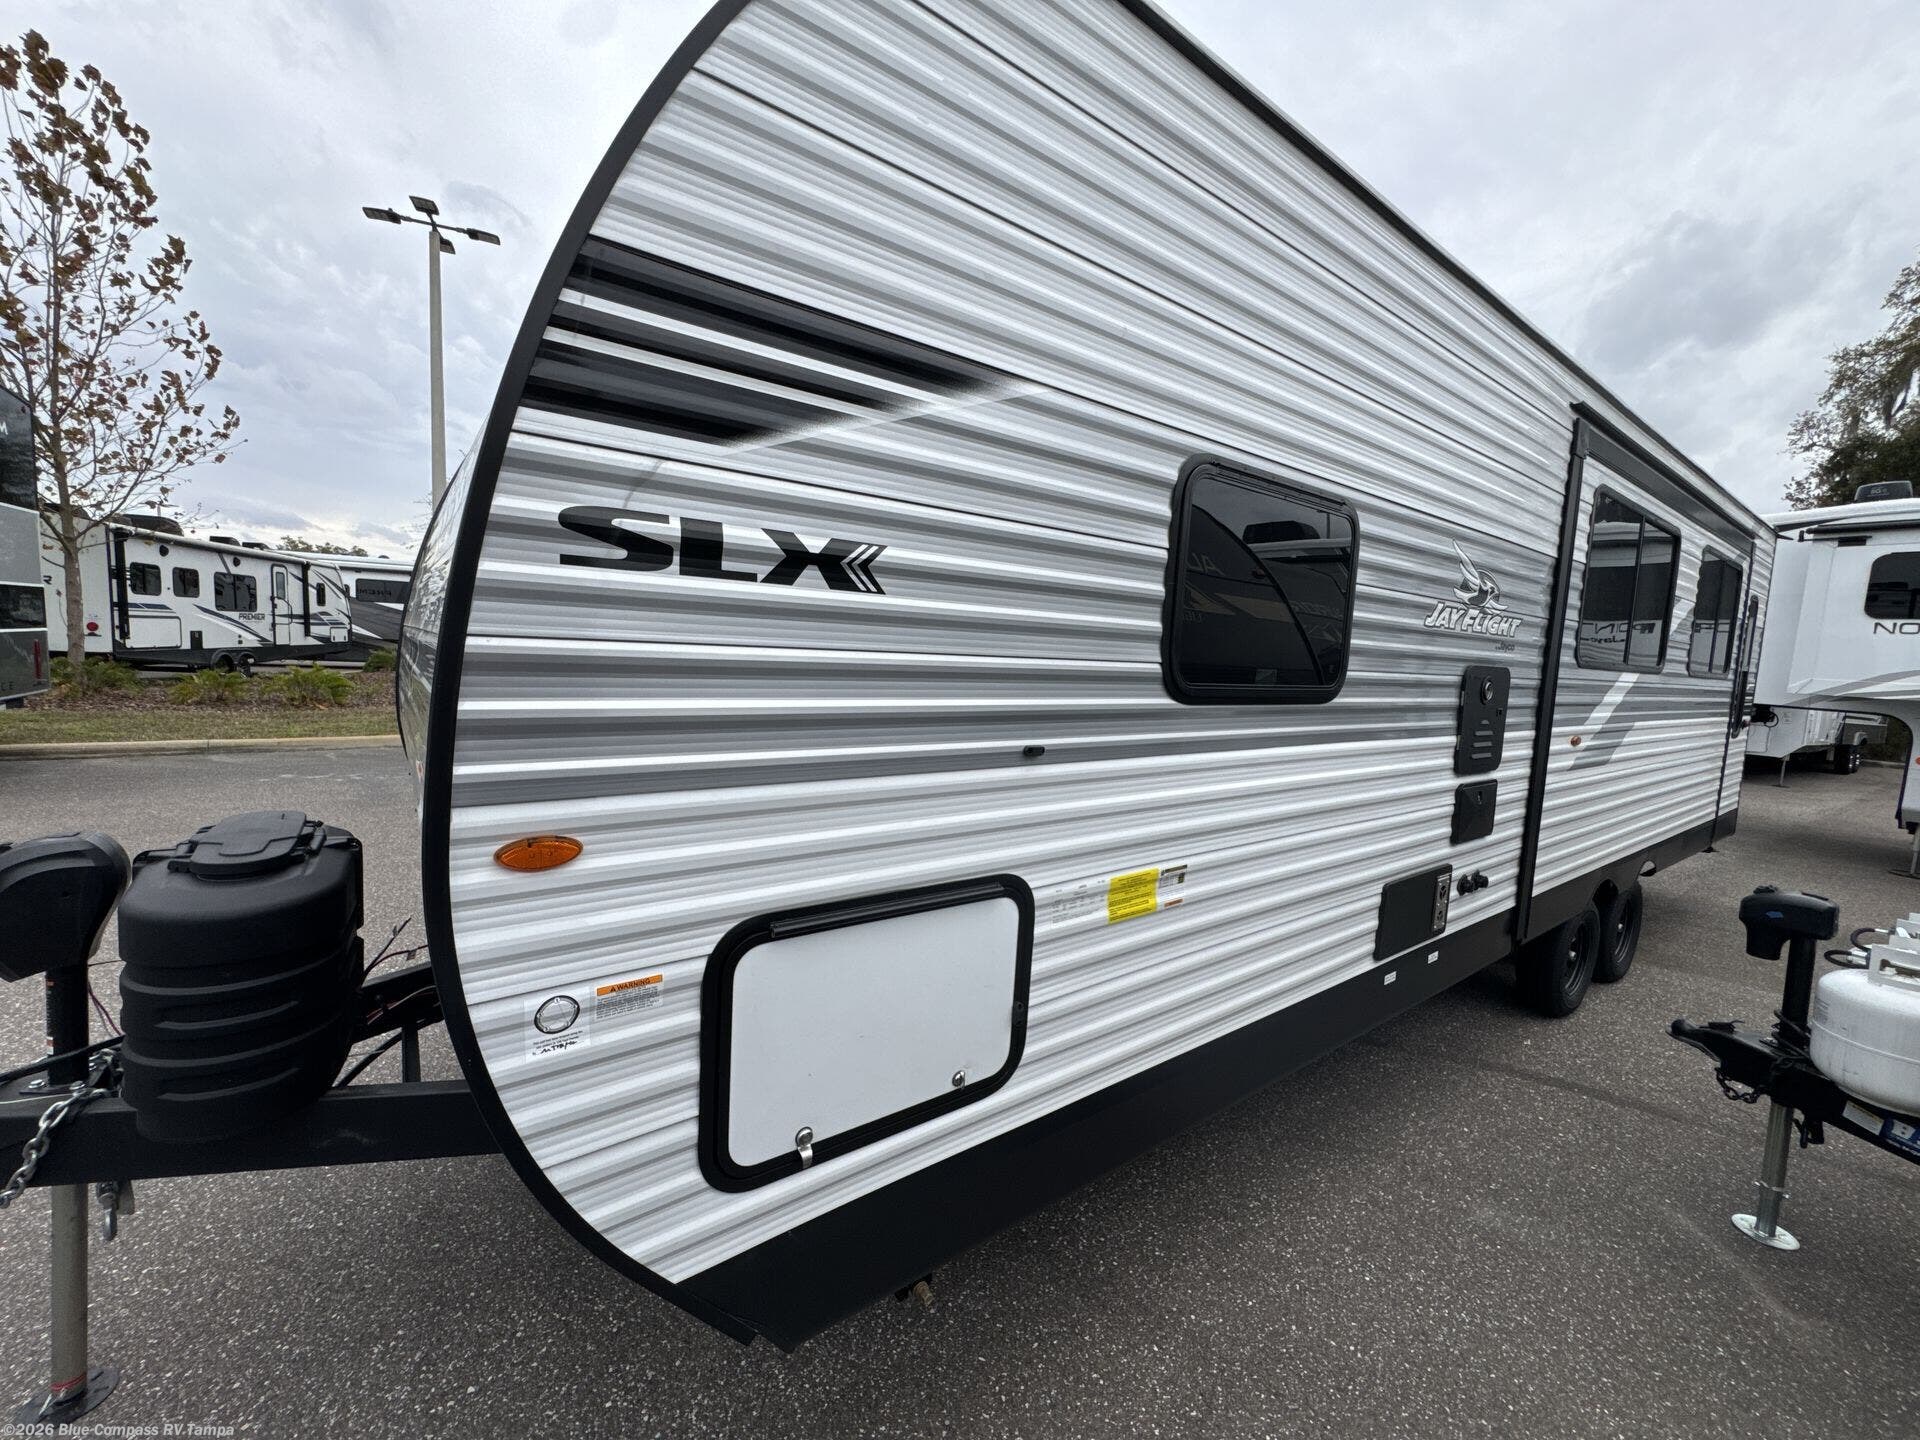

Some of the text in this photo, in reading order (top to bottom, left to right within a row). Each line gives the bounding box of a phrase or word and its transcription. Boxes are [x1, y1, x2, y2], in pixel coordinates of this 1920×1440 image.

[558, 505, 888, 595] SLX
[1424, 601, 1522, 638] JAY FLIGHT
[617, 977, 651, 991] WARNING
